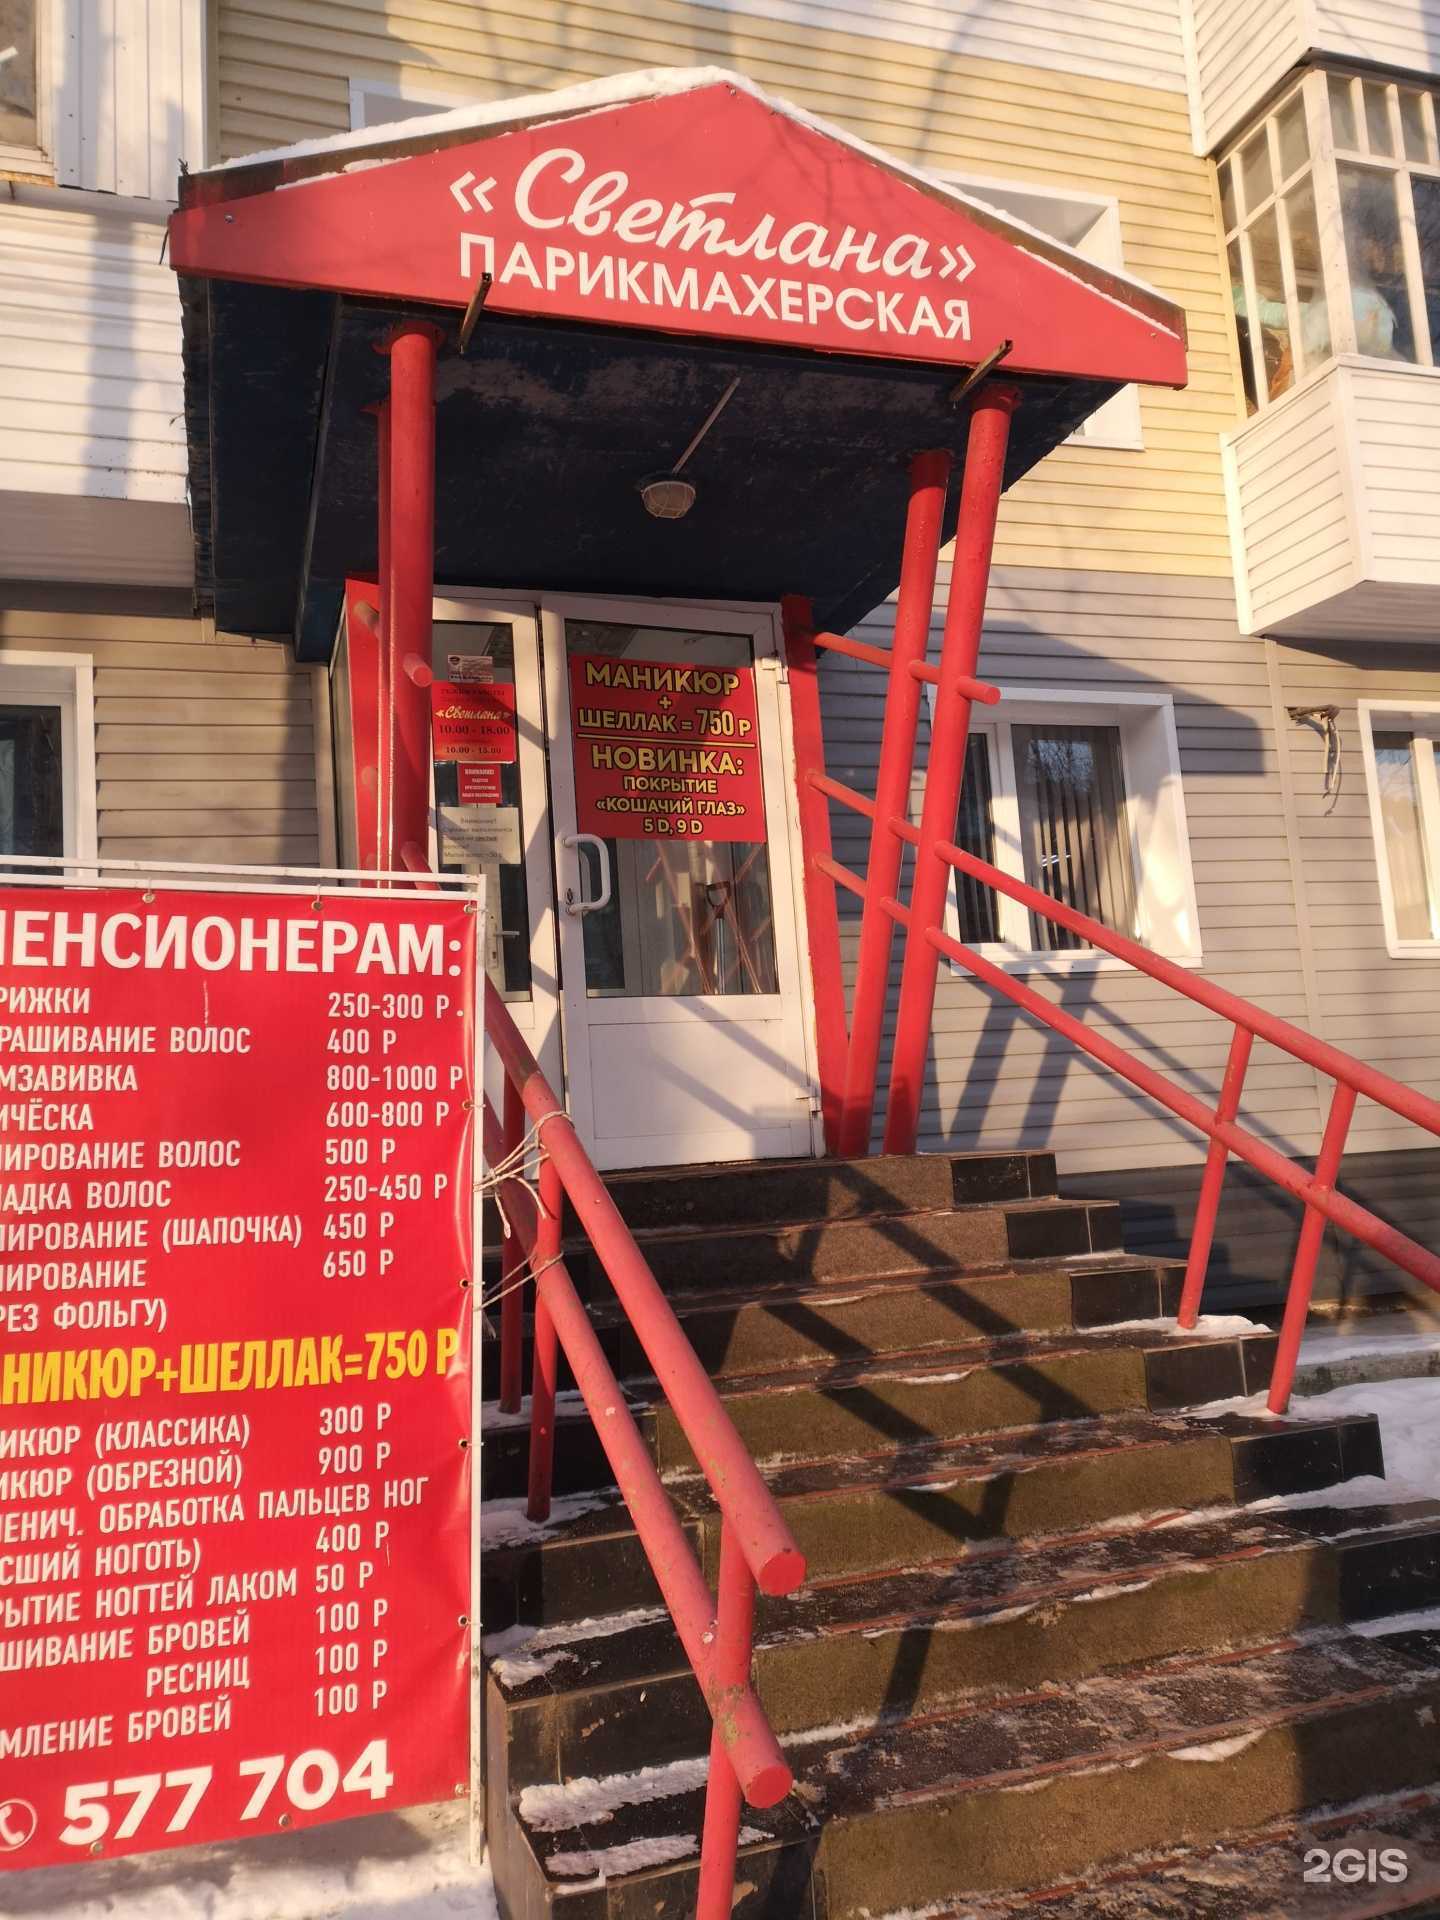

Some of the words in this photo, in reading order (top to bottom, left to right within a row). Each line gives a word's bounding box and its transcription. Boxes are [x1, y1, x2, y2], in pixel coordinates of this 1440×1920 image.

[459, 231, 973, 342] ПАРИКМАХЕРСКАЯ
[585, 662, 740, 696] МАНИКЮР
[578, 708, 679, 733] ШЕЛЛАК
[681, 720, 694, 731] =
[696, 709, 734, 736] 750
[658, 695, 673, 710] +
[592, 744, 745, 776] НОВИНКА:
[623, 775, 718, 794] ПОКРЫТИЕ
[596, 797, 694, 815] «КОШАЧИЙ
[697, 800, 746, 816] ГЛАЗ»
[328, 992, 423, 1019] 250-300
[0, 1025, 156, 1053] РАШИВАНИЕ
[170, 1026, 250, 1054] ВОЛОС
[327, 1028, 369, 1054] 400
[383, 1029, 397, 1054] Р
[0, 1064, 138, 1092] МЗАВИВКА
[327, 1064, 437, 1091] 800-1000
[450, 1065, 463, 1090] Р
[326, 1101, 423, 1128] 600-800
[436, 1101, 449, 1126] Р
[0, 1141, 145, 1171] ИРОВАНИЕ
[158, 1140, 241, 1168] ВОЛОС
[325, 1138, 368, 1165] 500
[381, 1138, 396, 1164] Р
[0, 1182, 72, 1215] АДКА
[86, 1180, 171, 1209] ВОЛОС
[324, 1174, 421, 1202] 250-450
[434, 1173, 448, 1199] Р
[162, 1215, 302, 1253] (ШАПОЧКА)
[323, 1212, 367, 1240] 450
[380, 1212, 394, 1237] Р
[0, 1259, 147, 1292] ИРОВАНИЕ
[323, 1250, 366, 1278] 650
[380, 1249, 394, 1275] Р
[53, 1298, 167, 1333] ФОЛЬГУ)
[435, 1328, 459, 1376] Р
[0, 1425, 81, 1459] ИКЮР
[95, 1414, 250, 1462] (КЛАССИКА)
[319, 1405, 363, 1436] 300
[377, 1403, 391, 1430] Р
[86, 1449, 242, 1504] (ОБРЕЗНОЙ)
[318, 1444, 362, 1475] 900
[376, 1442, 391, 1469] Р
[0, 1507, 83, 1547] ЕНИЧ.
[99, 1489, 245, 1534] ОБРАБОТКА
[258, 1483, 370, 1519] ПАЛЬЦЕВ
[384, 1477, 428, 1508] НОГ
[0, 1543, 80, 1586] СШИЙ
[95, 1538, 201, 1580] НОГОТЬ)
[315, 1523, 361, 1553] 400
[375, 1521, 390, 1549] Р
[0, 1591, 81, 1628] ЫТИЕ
[95, 1570, 193, 1619] НОГТЕЙ
[206, 1568, 297, 1606] ЛАКОМ
[315, 1563, 345, 1593] 50
[359, 1561, 373, 1589] Р
[0, 1628, 133, 1672] ШИВАНИЕ
[148, 1611, 249, 1655] БРОВЕЙ
[316, 1601, 359, 1634] 100
[373, 1598, 388, 1627] Р
[146, 1656, 250, 1701] РЕСНИЦ
[315, 1642, 359, 1675] 100
[373, 1639, 388, 1668] Р
[0, 1715, 113, 1759] МЛЕНИЕ
[128, 1696, 231, 1743] БРОВЕЙ
[314, 1683, 358, 1716] 100
[372, 1680, 387, 1709] Р
[59, 1765, 213, 1848] 577
[239, 1739, 394, 1825] 704
